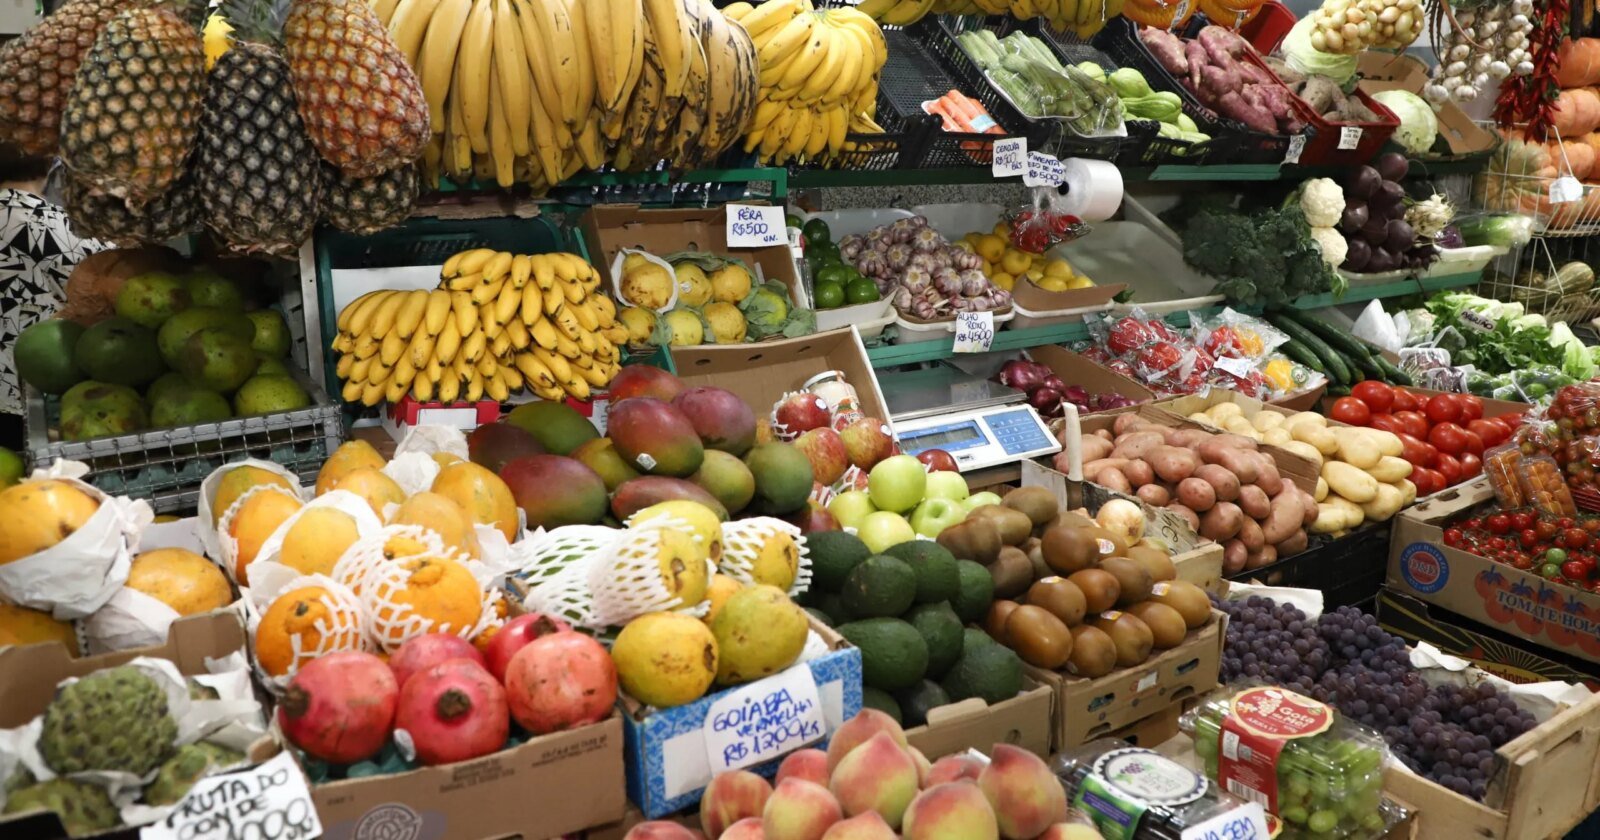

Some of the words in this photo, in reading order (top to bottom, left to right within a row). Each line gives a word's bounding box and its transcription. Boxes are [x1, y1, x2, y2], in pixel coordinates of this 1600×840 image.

[1027, 152, 1060, 168] PIMENTA
[1027, 161, 1041, 169] EDO
[737, 207, 764, 221] PÊRA
[958, 313, 979, 321] ALHO
[1496, 590, 1557, 622] TOMATE
[713, 688, 793, 732] GOIABA
[1280, 706, 1316, 725] Gota
[723, 742, 749, 767] R$
[257, 768, 288, 793] DO
